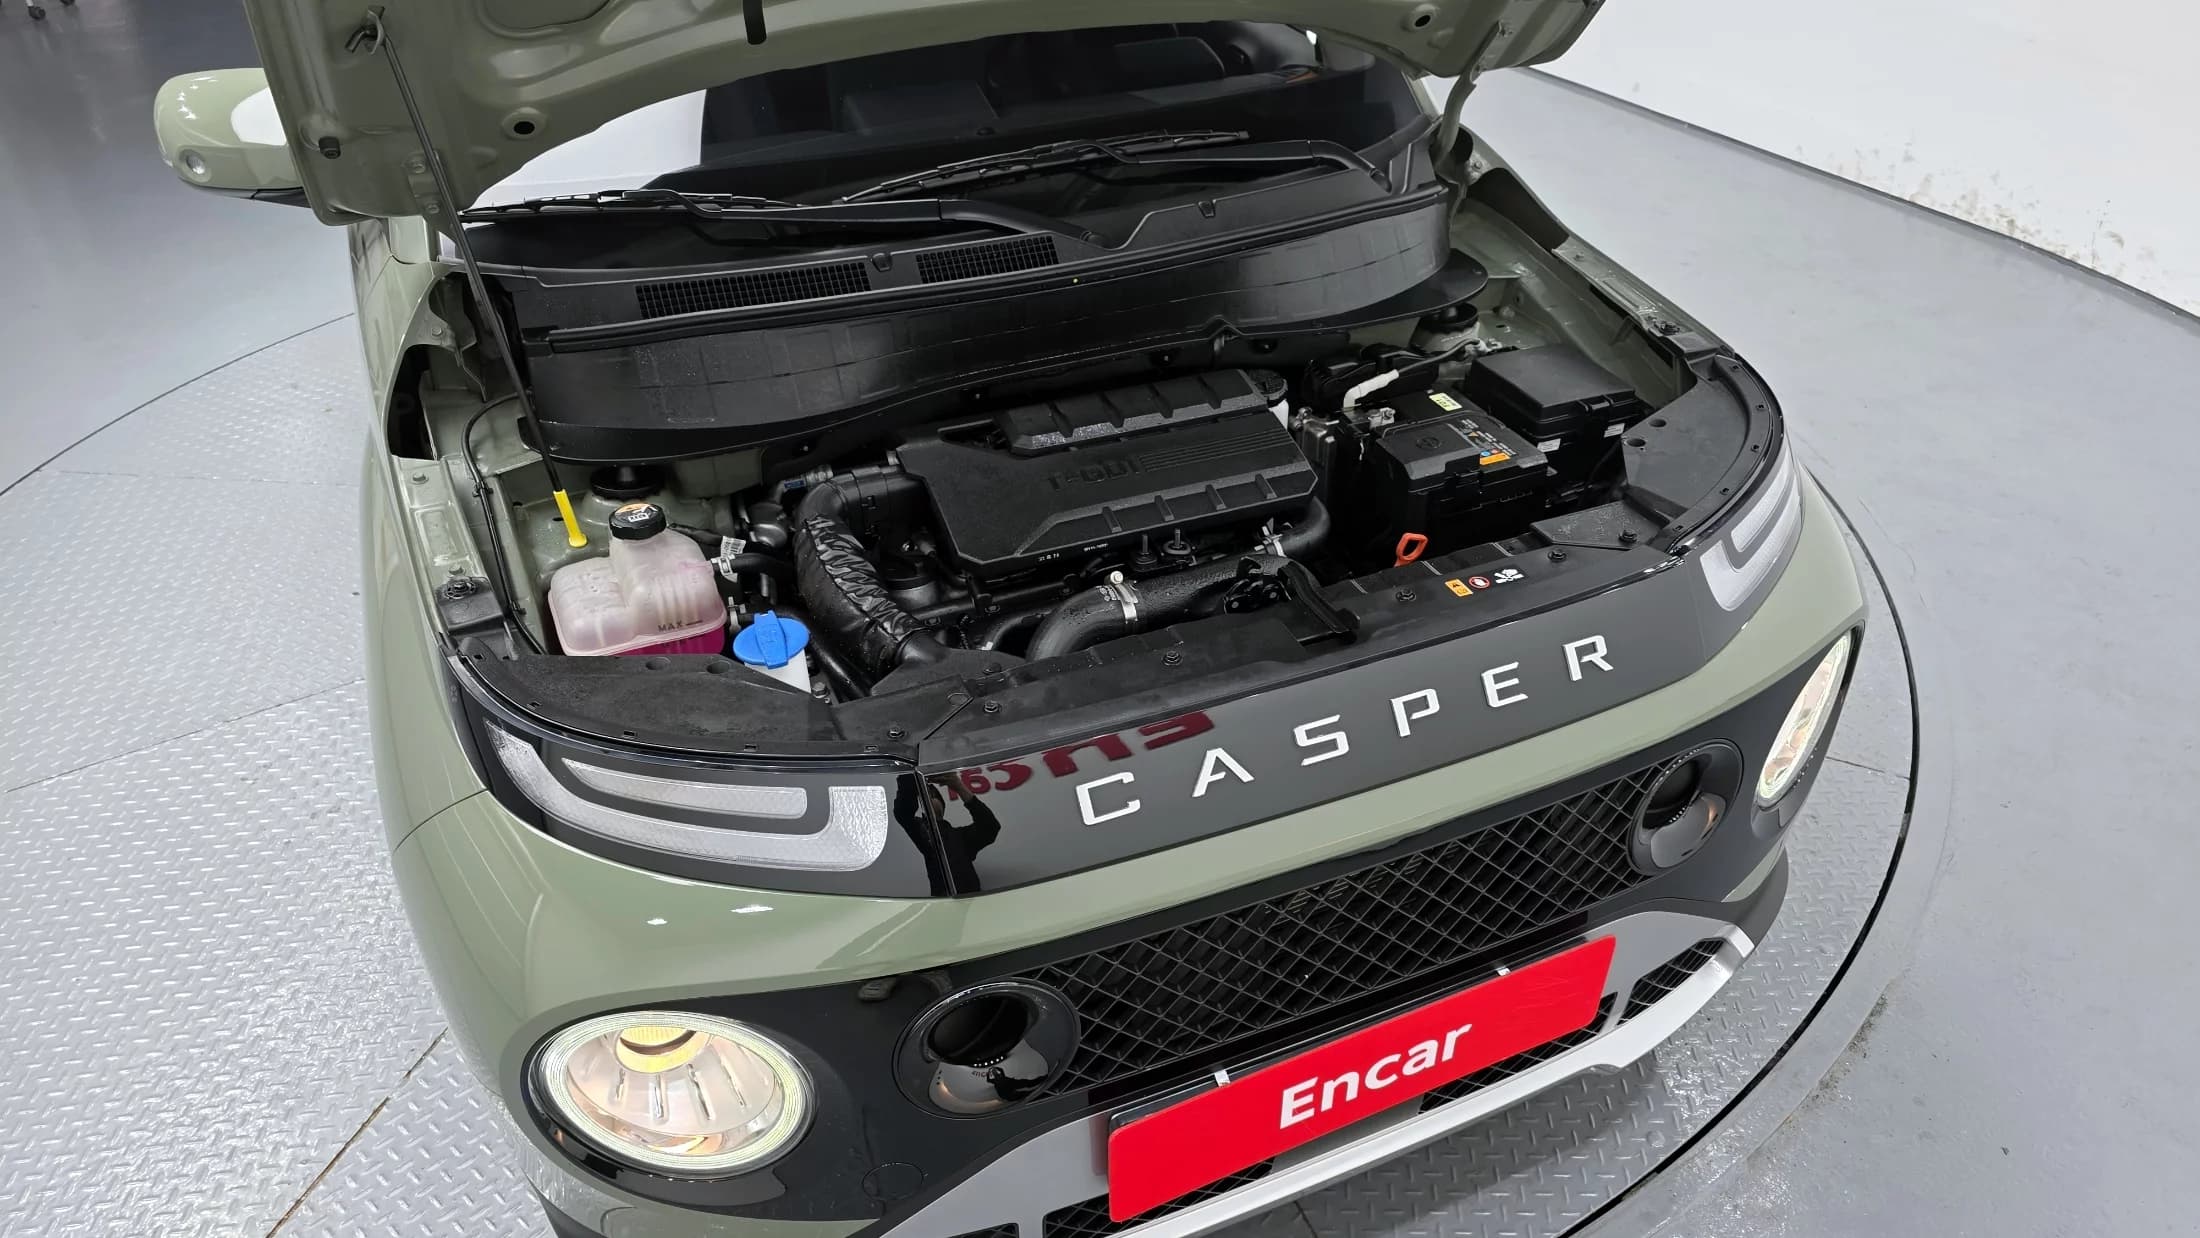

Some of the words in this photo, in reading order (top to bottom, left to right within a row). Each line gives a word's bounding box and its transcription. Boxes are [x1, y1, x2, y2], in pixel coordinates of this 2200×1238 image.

[657, 620, 683, 633] MAX
[1075, 634, 1614, 826] CASPER
[1279, 1023, 1472, 1129] Encar
